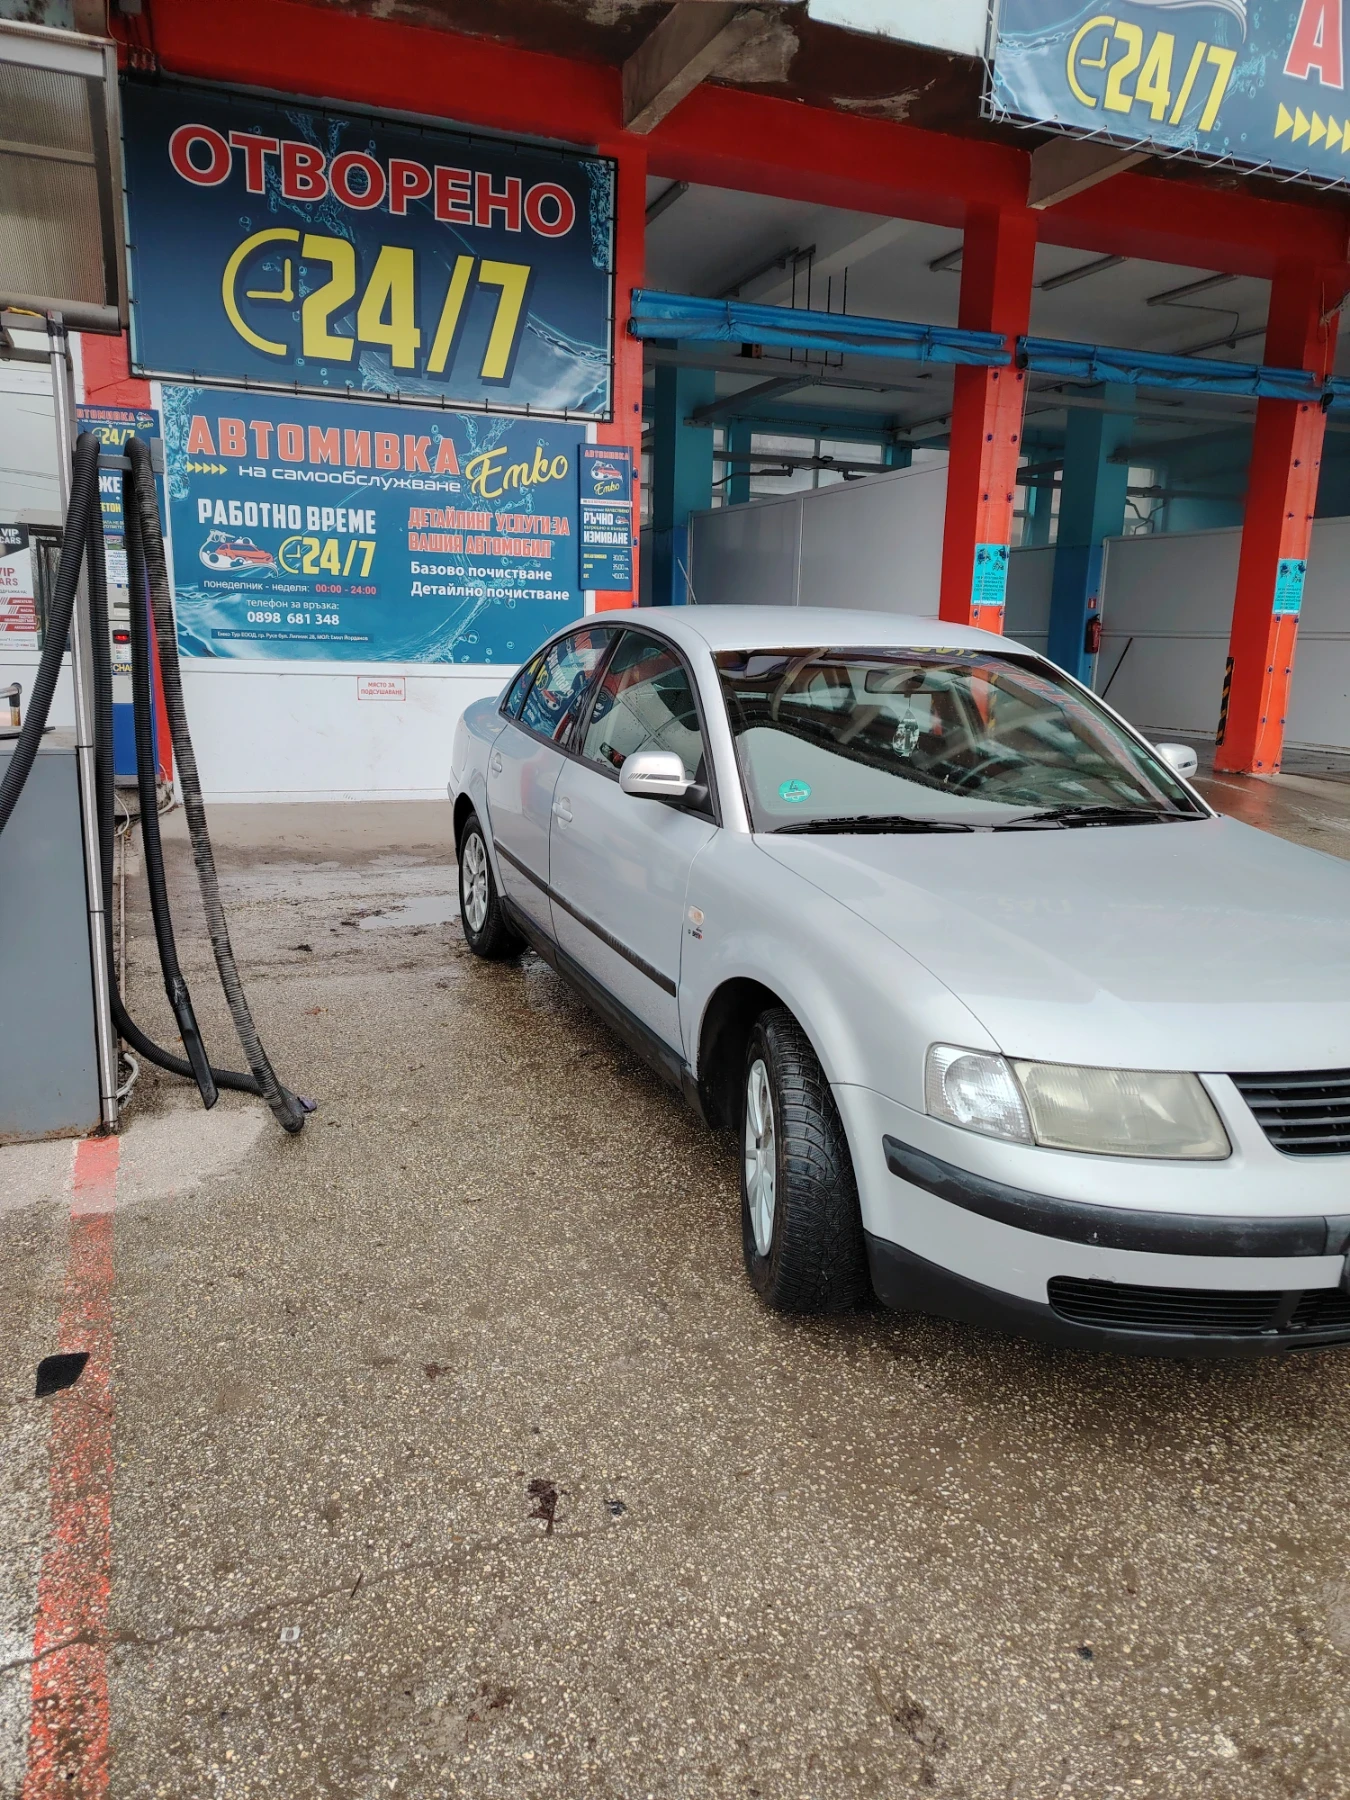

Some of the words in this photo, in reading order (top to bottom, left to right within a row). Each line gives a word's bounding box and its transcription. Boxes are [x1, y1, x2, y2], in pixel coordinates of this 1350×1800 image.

[1104, 21, 1237, 132] 24/7
[168, 123, 576, 238] ОТВОРЕНО
[301, 234, 531, 379] 24/7
[77, 409, 135, 422] ВТОМИВКА
[187, 415, 460, 476] АВТОМИВКА
[238, 466, 267, 478] на
[271, 468, 461, 493] самообслужване
[197, 498, 302, 530] РАБОТНО
[306, 506, 376, 534] ВРЕМЕ
[408, 506, 493, 531] ДЕТАЙЛИНГ
[495, 513, 550, 534] УСЛУГИ
[550, 516, 570, 536] ЗА
[583, 512, 614, 525] РЪЧНО
[0, 528, 19, 536] VIP
[583, 531, 628, 545] ИЗМИВАНЕ
[408, 532, 463, 553] ВАШИЯ
[465, 536, 552, 558] АВТОМОБИЛ
[302, 537, 376, 577] 24/7
[0, 568, 14, 576] IP
[411, 561, 465, 576] Базово
[469, 567, 553, 581] почистване
[0, 578, 18, 586] ARS
[203, 580, 263, 591] понеделник
[272, 584, 310, 592] неделя:
[315, 584, 342, 594] 00:00
[351, 585, 377, 595] 24:00
[411, 582, 483, 597] Детайлно
[487, 587, 570, 601] почистване
[247, 599, 288, 609] телефон
[247, 611, 281, 623] 0898
[287, 612, 311, 624] 681
[315, 614, 340, 625] 348
